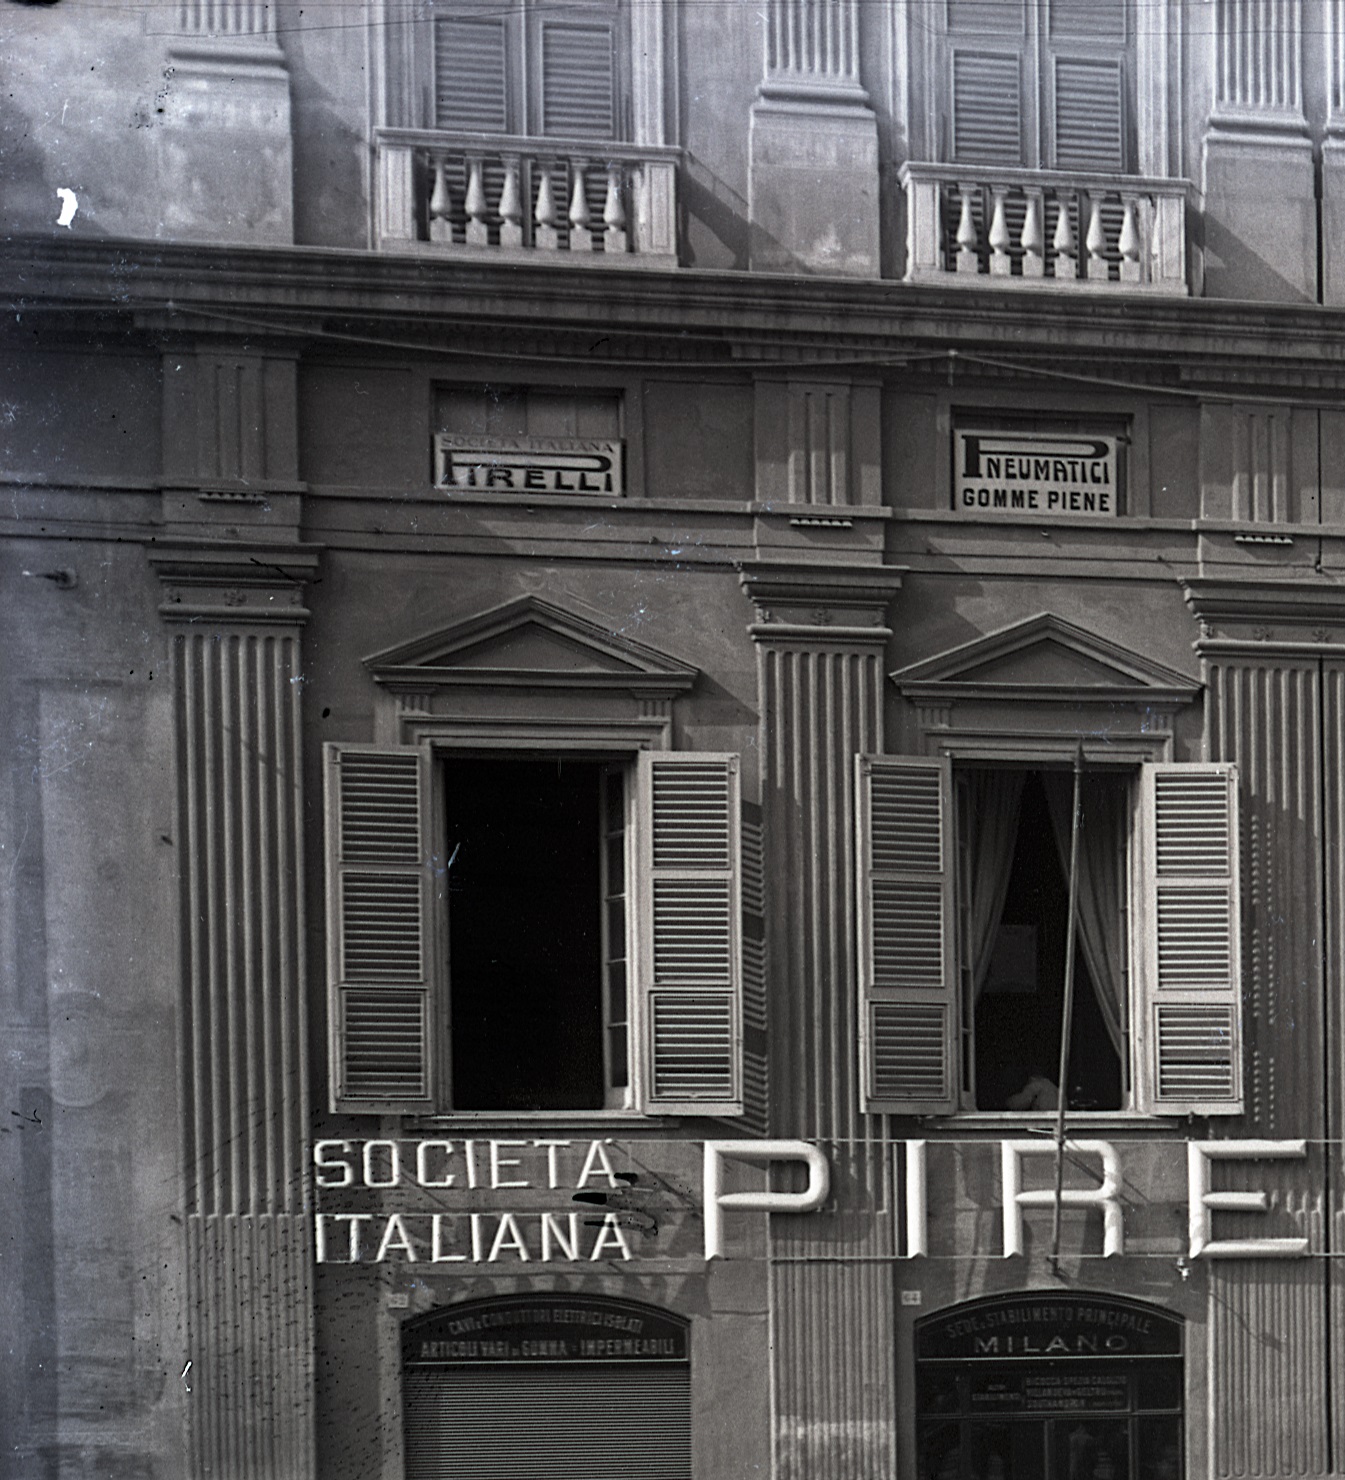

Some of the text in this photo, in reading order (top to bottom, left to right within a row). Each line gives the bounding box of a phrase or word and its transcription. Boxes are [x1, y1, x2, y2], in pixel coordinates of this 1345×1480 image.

[441, 449, 614, 492] PIRELLI
[962, 434, 1109, 484] PNEUMATICI
[963, 488, 1109, 512] GOMME PIENE
[318, 1213, 635, 1264] ITALIANA
[946, 1321, 982, 1339] SEDE
[987, 1306, 1074, 1328] STABILIMENTO
[1077, 1306, 1152, 1335] PRINCIPALE
[421, 1341, 478, 1357] ARTICOLI
[480, 1341, 509, 1357] VARI
[521, 1340, 569, 1356] GOMMA
[580, 1339, 674, 1356] IMPERMEABILI
[975, 1336, 1128, 1353] MILANO
